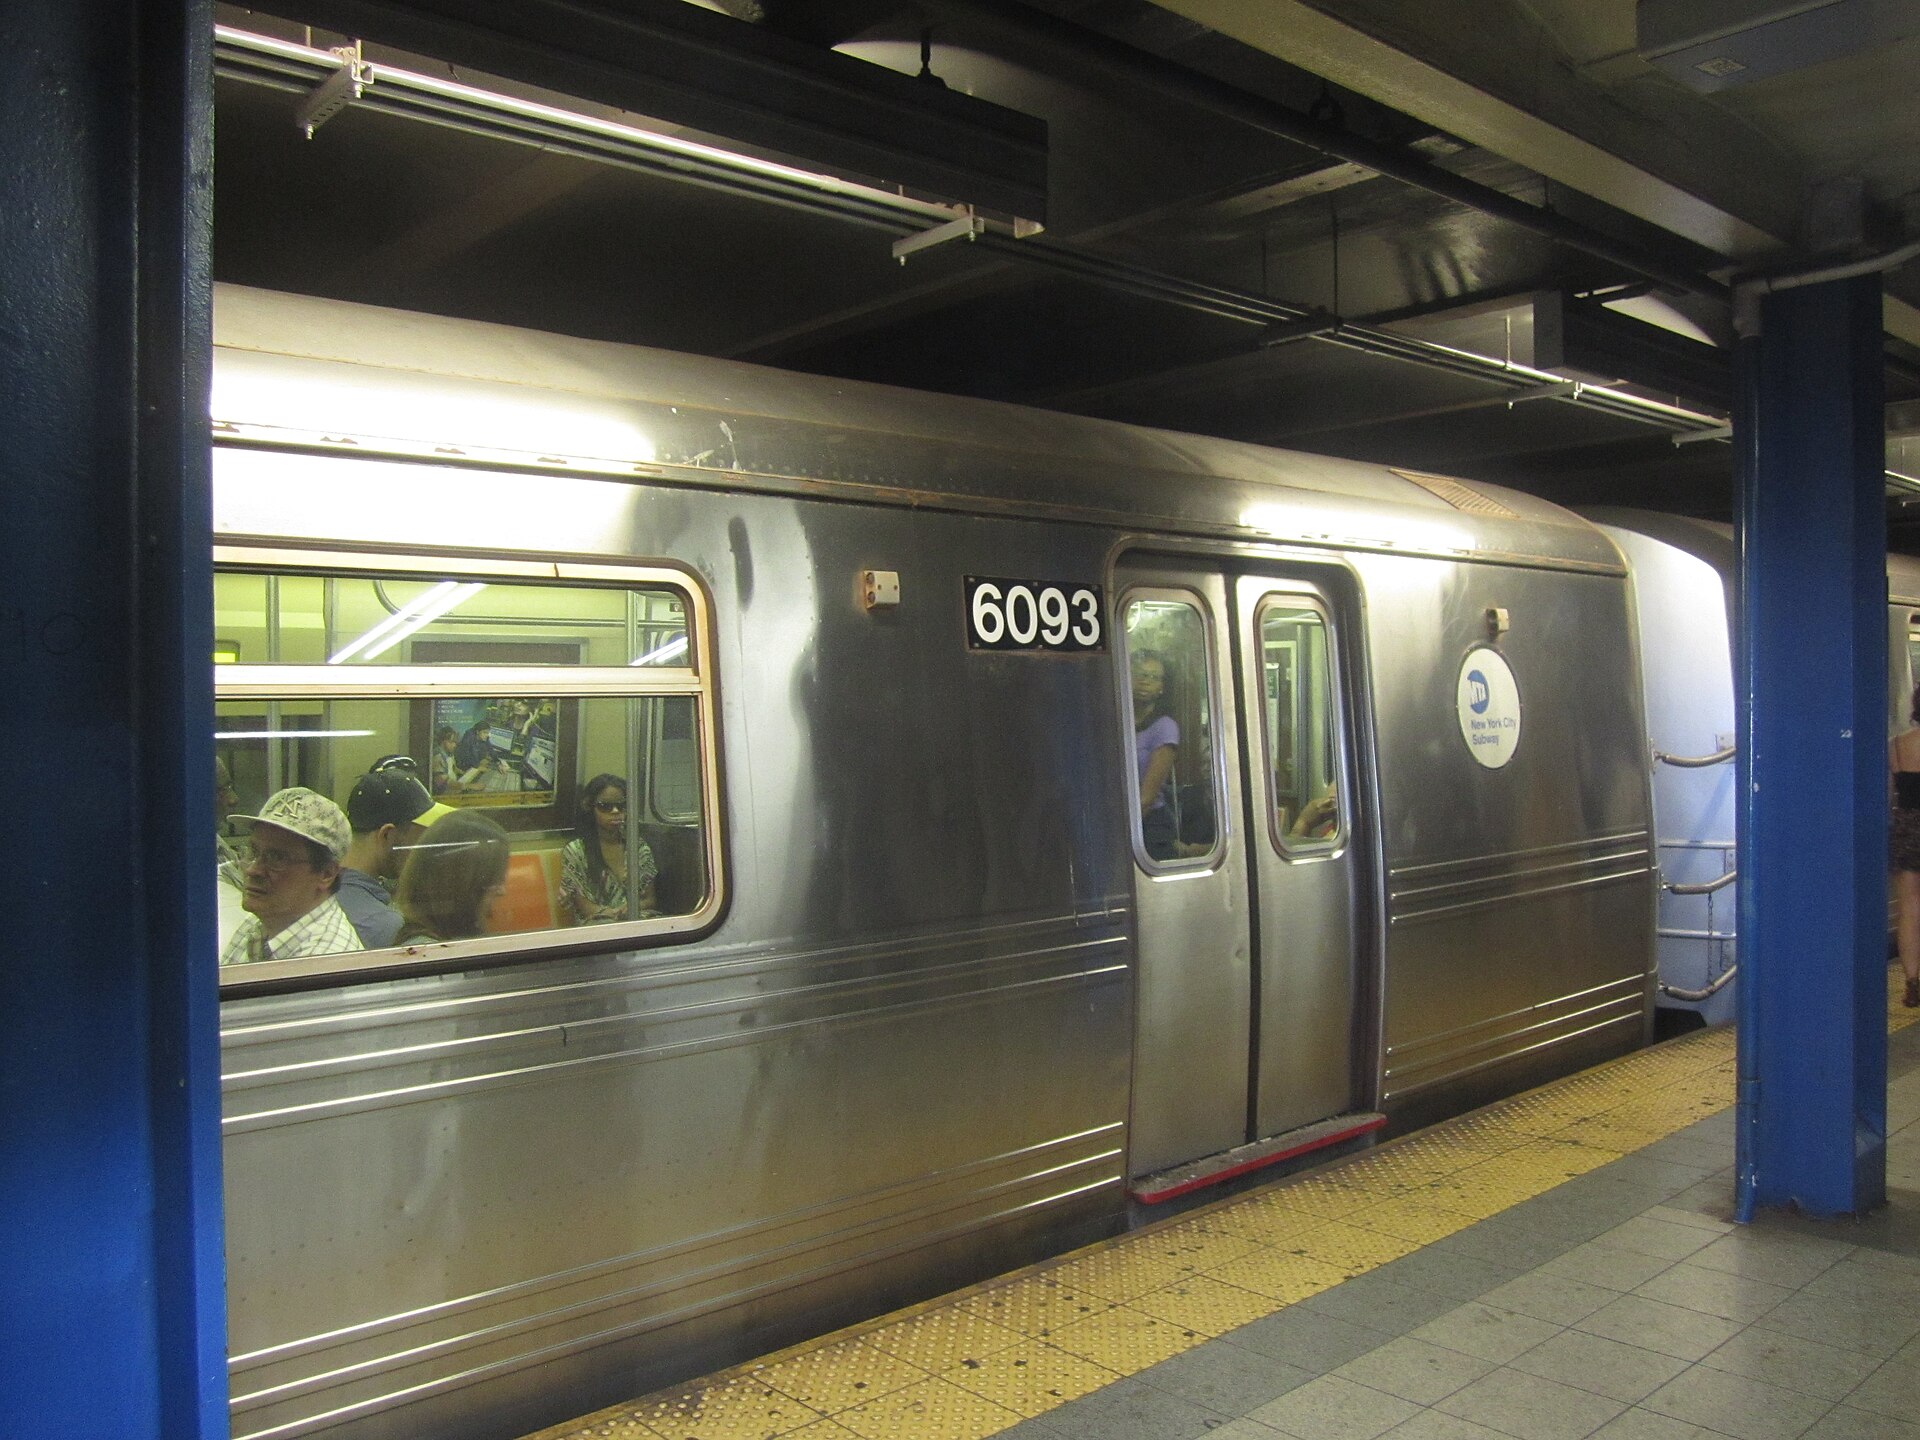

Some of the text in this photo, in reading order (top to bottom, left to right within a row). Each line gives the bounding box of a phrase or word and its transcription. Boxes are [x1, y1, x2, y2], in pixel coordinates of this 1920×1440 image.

[972, 583, 1101, 646] 6093
[1470, 716, 1516, 730] New York City
[1472, 734, 1499, 746] Subway
